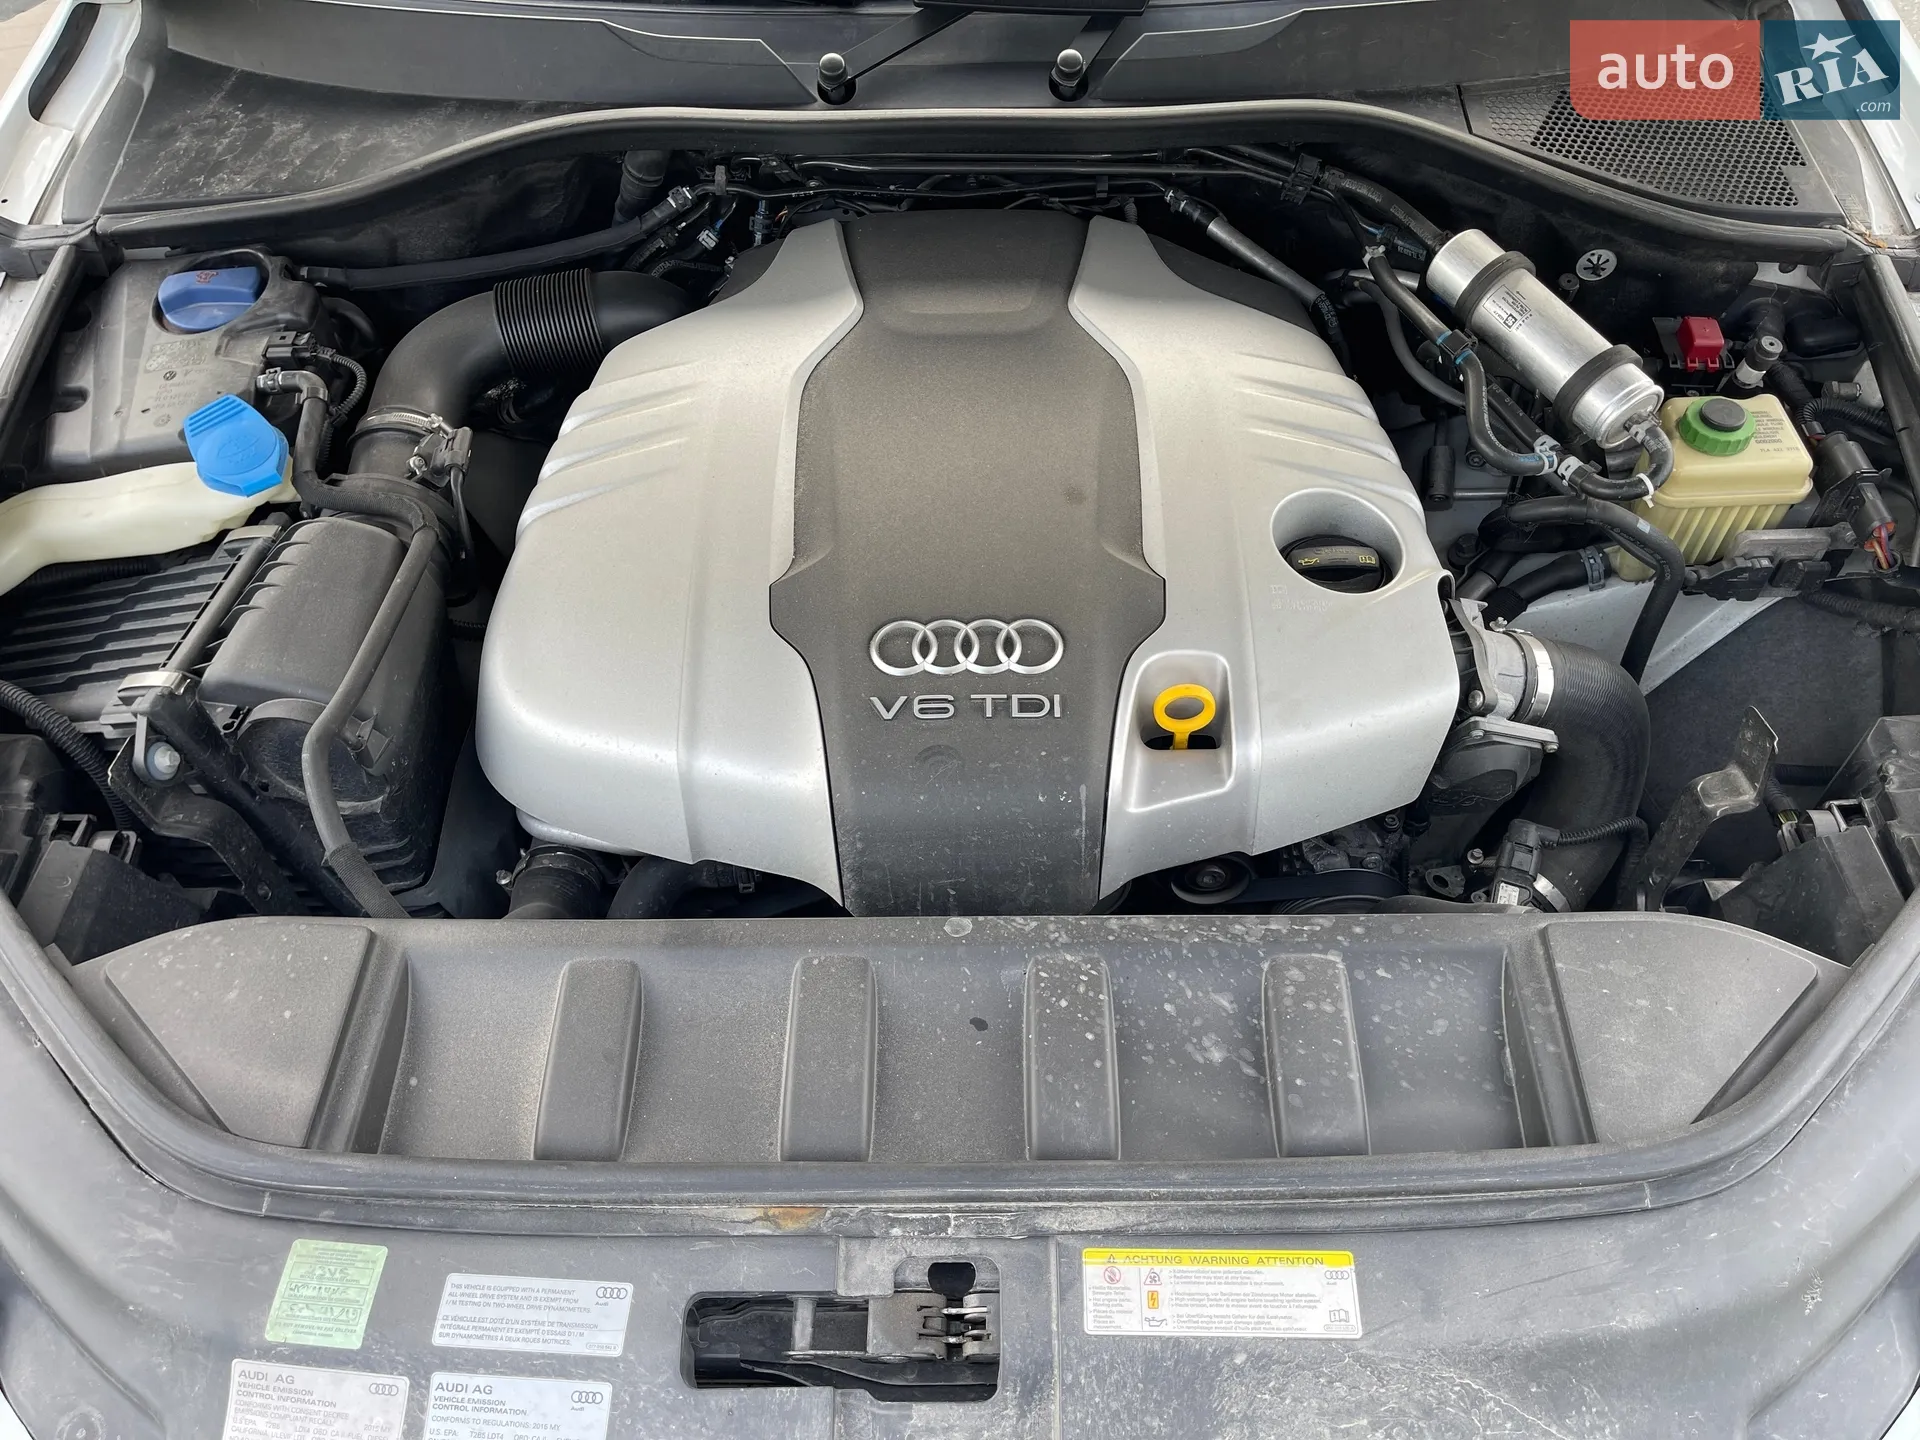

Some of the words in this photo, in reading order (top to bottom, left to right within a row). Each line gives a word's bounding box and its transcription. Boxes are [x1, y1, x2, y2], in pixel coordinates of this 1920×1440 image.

[870, 694, 954, 720] V6
[970, 694, 1061, 718] TDI
[1124, 1255, 1182, 1264] ACHTUNG
[1188, 1255, 1249, 1265] WARNING
[1256, 1256, 1324, 1265] ATTENTION
[464, 1283, 485, 1291] VEHICLE
[448, 1291, 478, 1299] ALL-WHEEL
[492, 1302, 525, 1310] TWO-WHEEL
[544, 1305, 592, 1313] DYNAMOMETERS.
[471, 1325, 506, 1334] PERMANENT
[556, 1321, 598, 1330] TRANSMISSION
[521, 1336, 541, 1344] ROUES
[238, 1370, 268, 1381] AUDI
[275, 1374, 295, 1384] AG
[238, 1380, 270, 1391] VEHICLE
[272, 1386, 314, 1396] EMISSION
[434, 1382, 468, 1393] AUDI
[472, 1384, 493, 1395] AG
[236, 1389, 275, 1400] CONTROL
[277, 1395, 337, 1408] INFORMATION
[433, 1395, 466, 1403] VEHICLE
[467, 1398, 506, 1406] EMISSION
[234, 1407, 269, 1418] EMISSIONS
[235, 1400, 272, 1410] CONFORMS
[290, 1407, 322, 1415] CONSENT
[323, 1411, 349, 1420] DECREE
[432, 1403, 470, 1412] CONTROL
[471, 1406, 527, 1416] INFORMATION
[431, 1415, 470, 1425] CONFORMS
[482, 1418, 531, 1428] REGULATIONS:
[549, 1423, 561, 1431] MY
